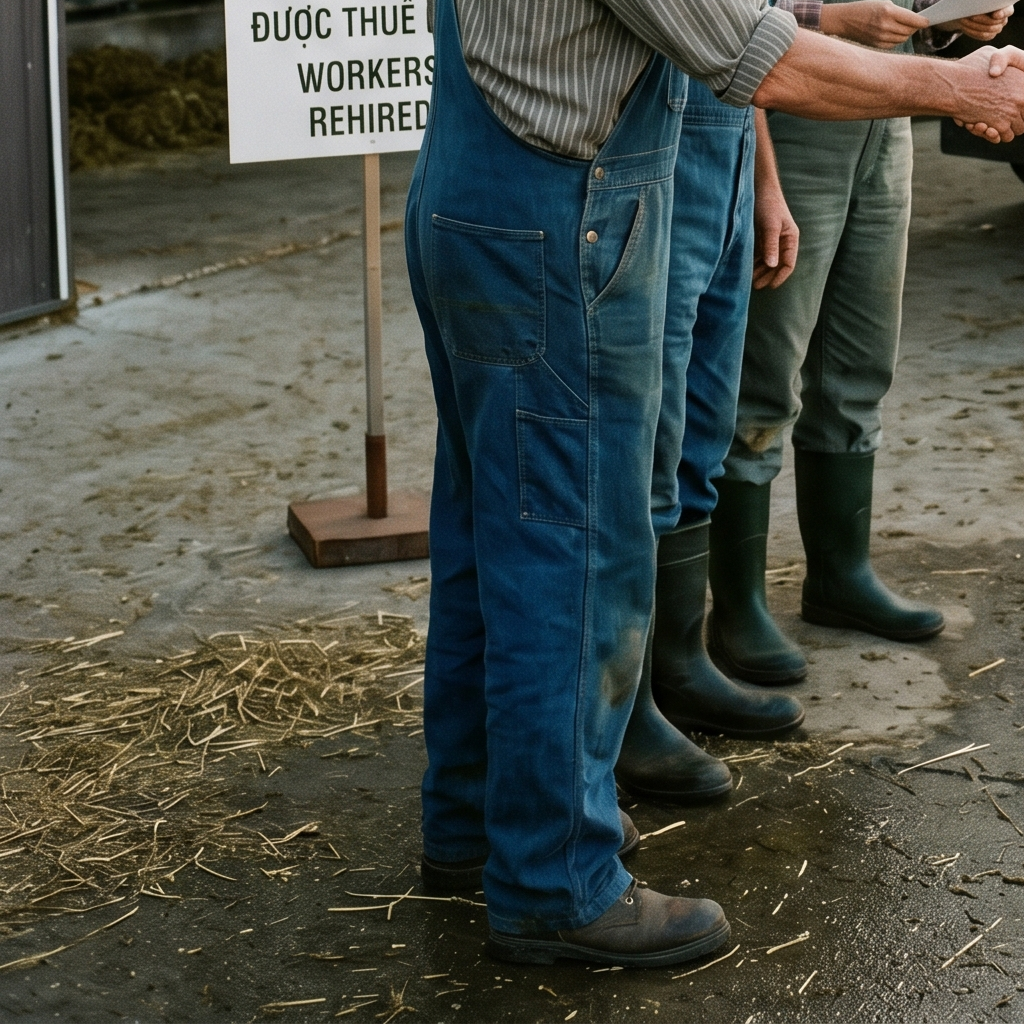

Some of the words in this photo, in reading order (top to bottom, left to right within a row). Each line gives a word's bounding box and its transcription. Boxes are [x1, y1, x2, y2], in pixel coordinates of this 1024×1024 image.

[251, 5, 332, 48] ĐƯỢC
[297, 55, 434, 93] WORKERS
[309, 100, 430, 137] REHIRED
